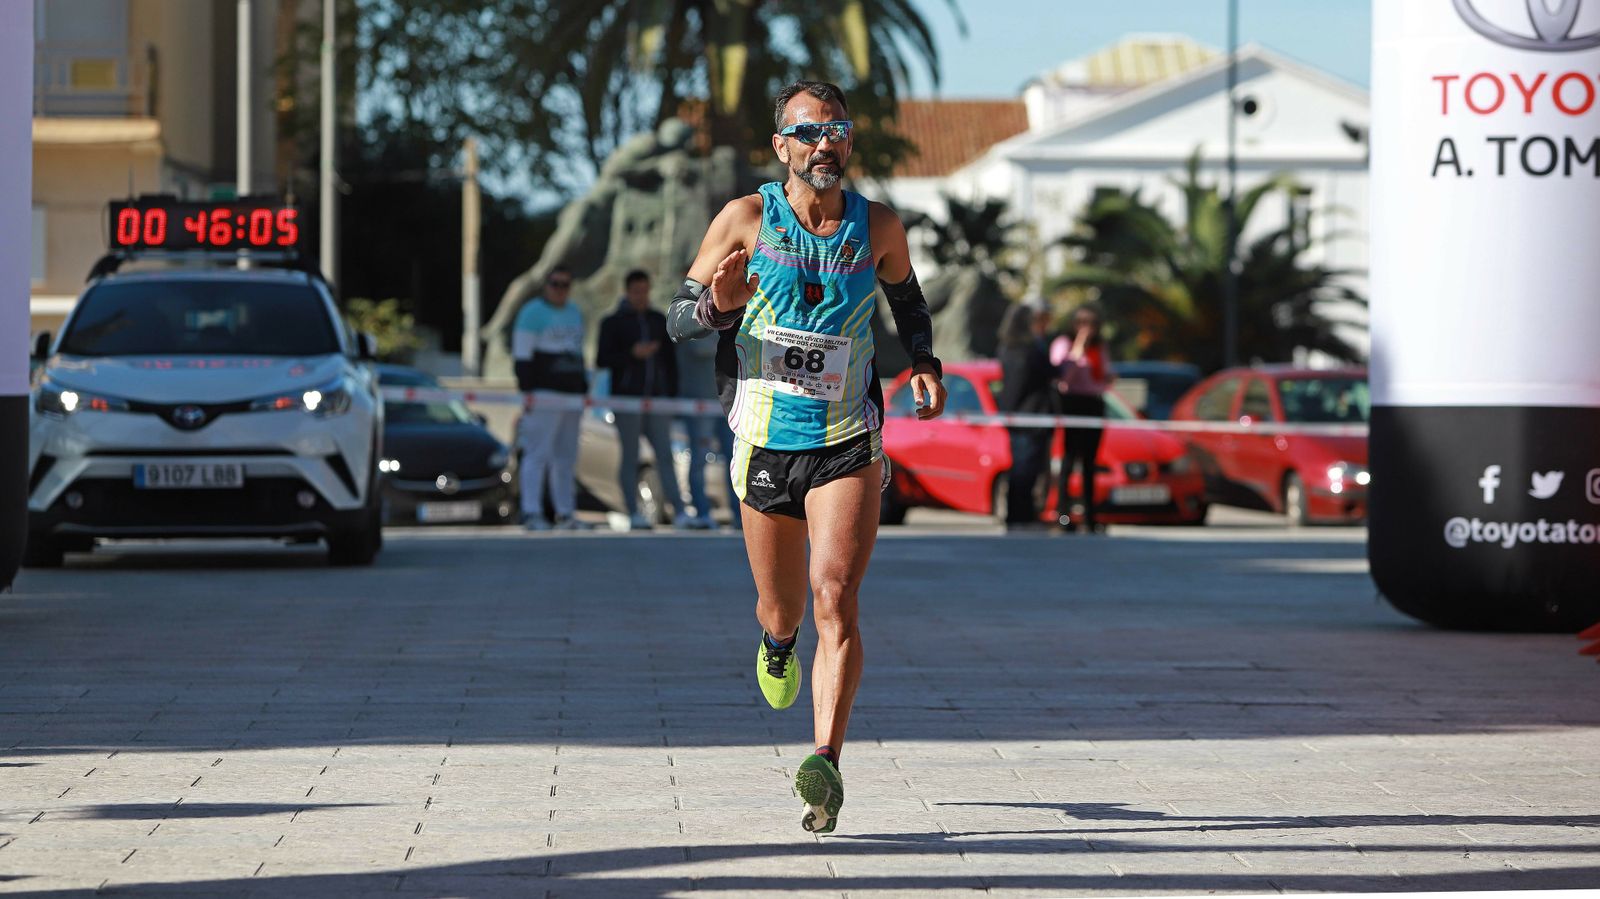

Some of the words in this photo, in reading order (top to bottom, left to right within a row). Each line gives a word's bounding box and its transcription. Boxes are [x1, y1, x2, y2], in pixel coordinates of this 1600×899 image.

[1431, 71, 1600, 117] TOYO
[1431, 137, 1474, 178] A.
[117, 207, 167, 246] 00
[184, 207, 298, 246] 46:05
[775, 331, 803, 340] CARRERA
[824, 338, 848, 346] MILITAR
[809, 342, 838, 350] CIUDADES
[784, 346, 826, 373] 68
[148, 464, 195, 487] 9107
[202, 465, 238, 487] LBB
[1443, 516, 1600, 549] @toyotato
